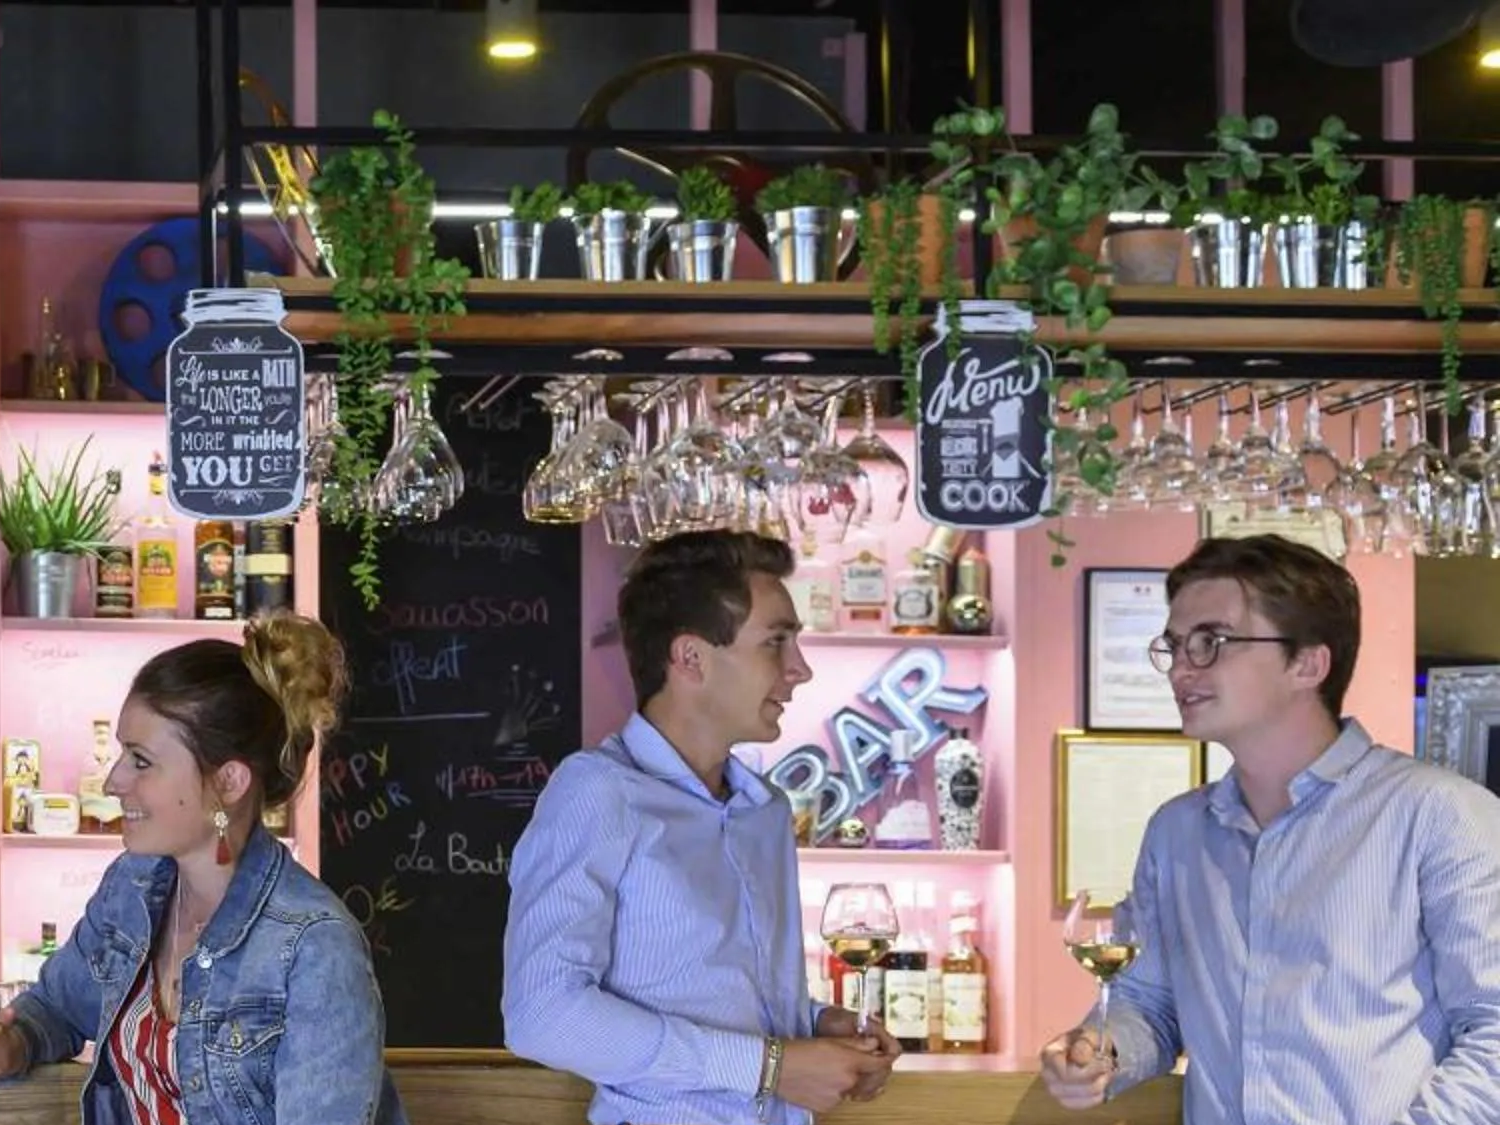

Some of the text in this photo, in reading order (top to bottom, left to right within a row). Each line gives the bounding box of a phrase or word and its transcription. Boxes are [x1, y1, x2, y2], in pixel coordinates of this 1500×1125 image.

[175, 355, 296, 392] Life IS LIKE A BATH
[926, 348, 1040, 425] Menu
[200, 386, 263, 413] LONGER
[211, 415, 260, 426] IN IT THE
[180, 429, 293, 451] MORE wrinkled
[182, 455, 293, 486] YOU GET
[941, 479, 1030, 512] COOK
[766, 647, 990, 847] BAR
[331, 781, 413, 847] HOUR
